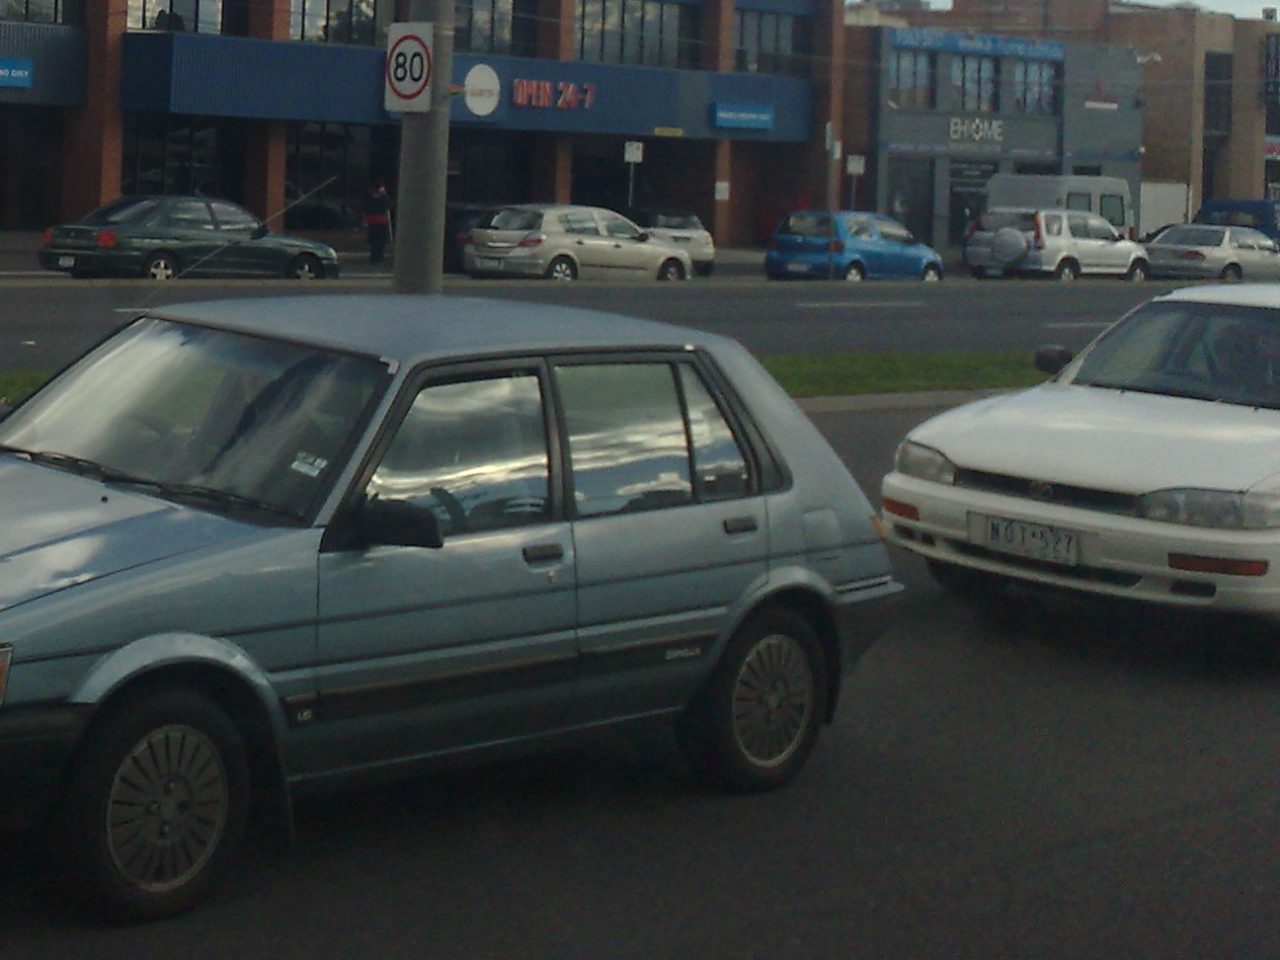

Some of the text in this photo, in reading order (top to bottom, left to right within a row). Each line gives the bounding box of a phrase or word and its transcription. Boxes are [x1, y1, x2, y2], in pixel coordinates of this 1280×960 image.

[394, 51, 424, 82] 80
[513, 78, 596, 109] OPEN 24-7
